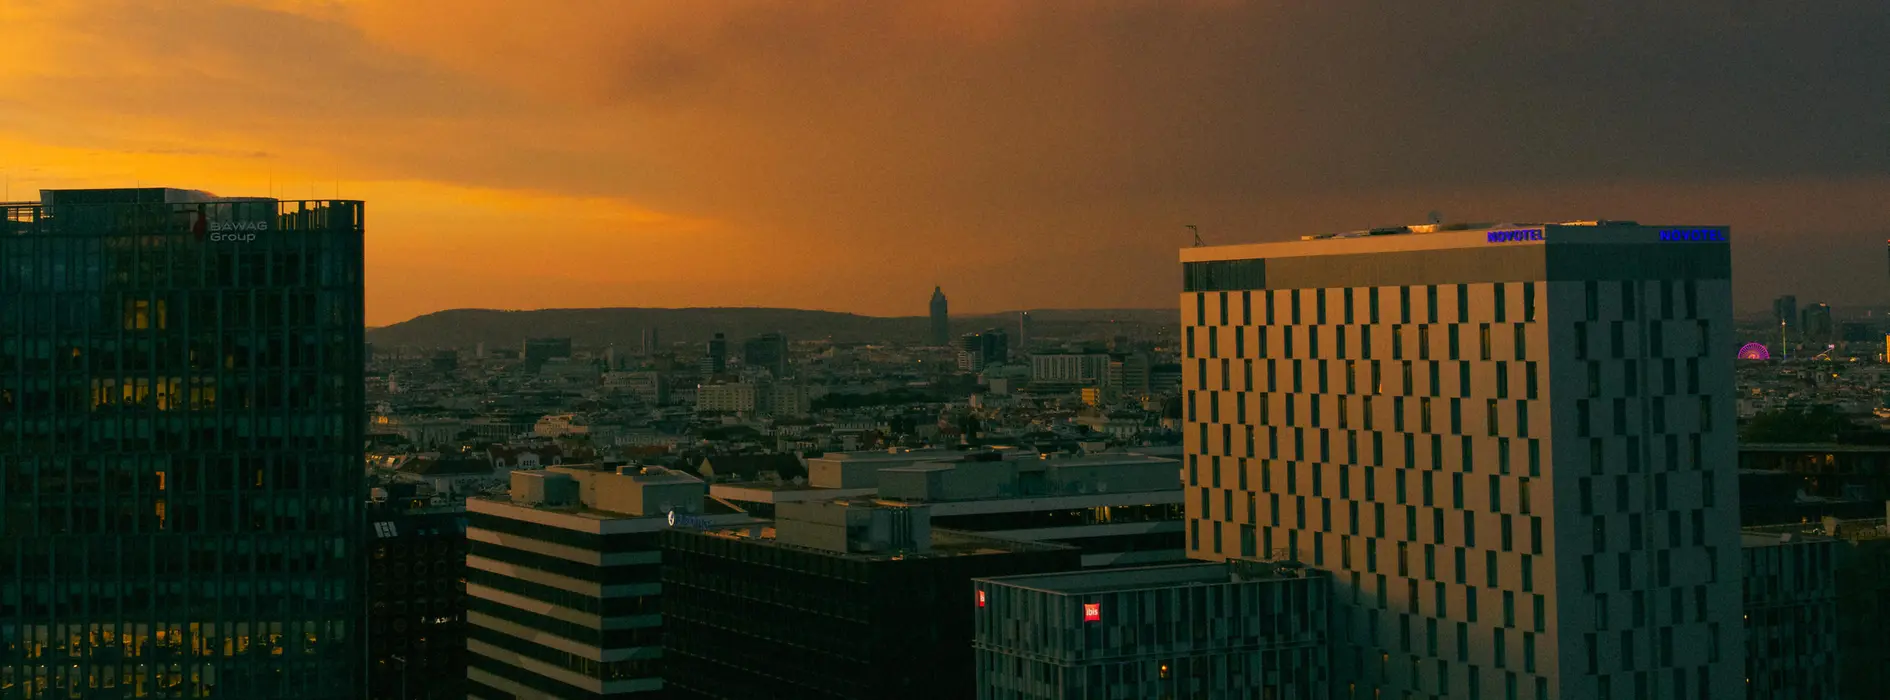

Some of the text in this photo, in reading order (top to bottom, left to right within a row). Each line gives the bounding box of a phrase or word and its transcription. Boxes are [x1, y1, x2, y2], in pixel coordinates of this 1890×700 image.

[210, 220, 268, 231] BAWAG
[210, 232, 256, 243] Group
[1487, 229, 1544, 243] NOVOTEL
[1658, 229, 1726, 241] NOVOTEL
[1086, 607, 1099, 617] ibis
